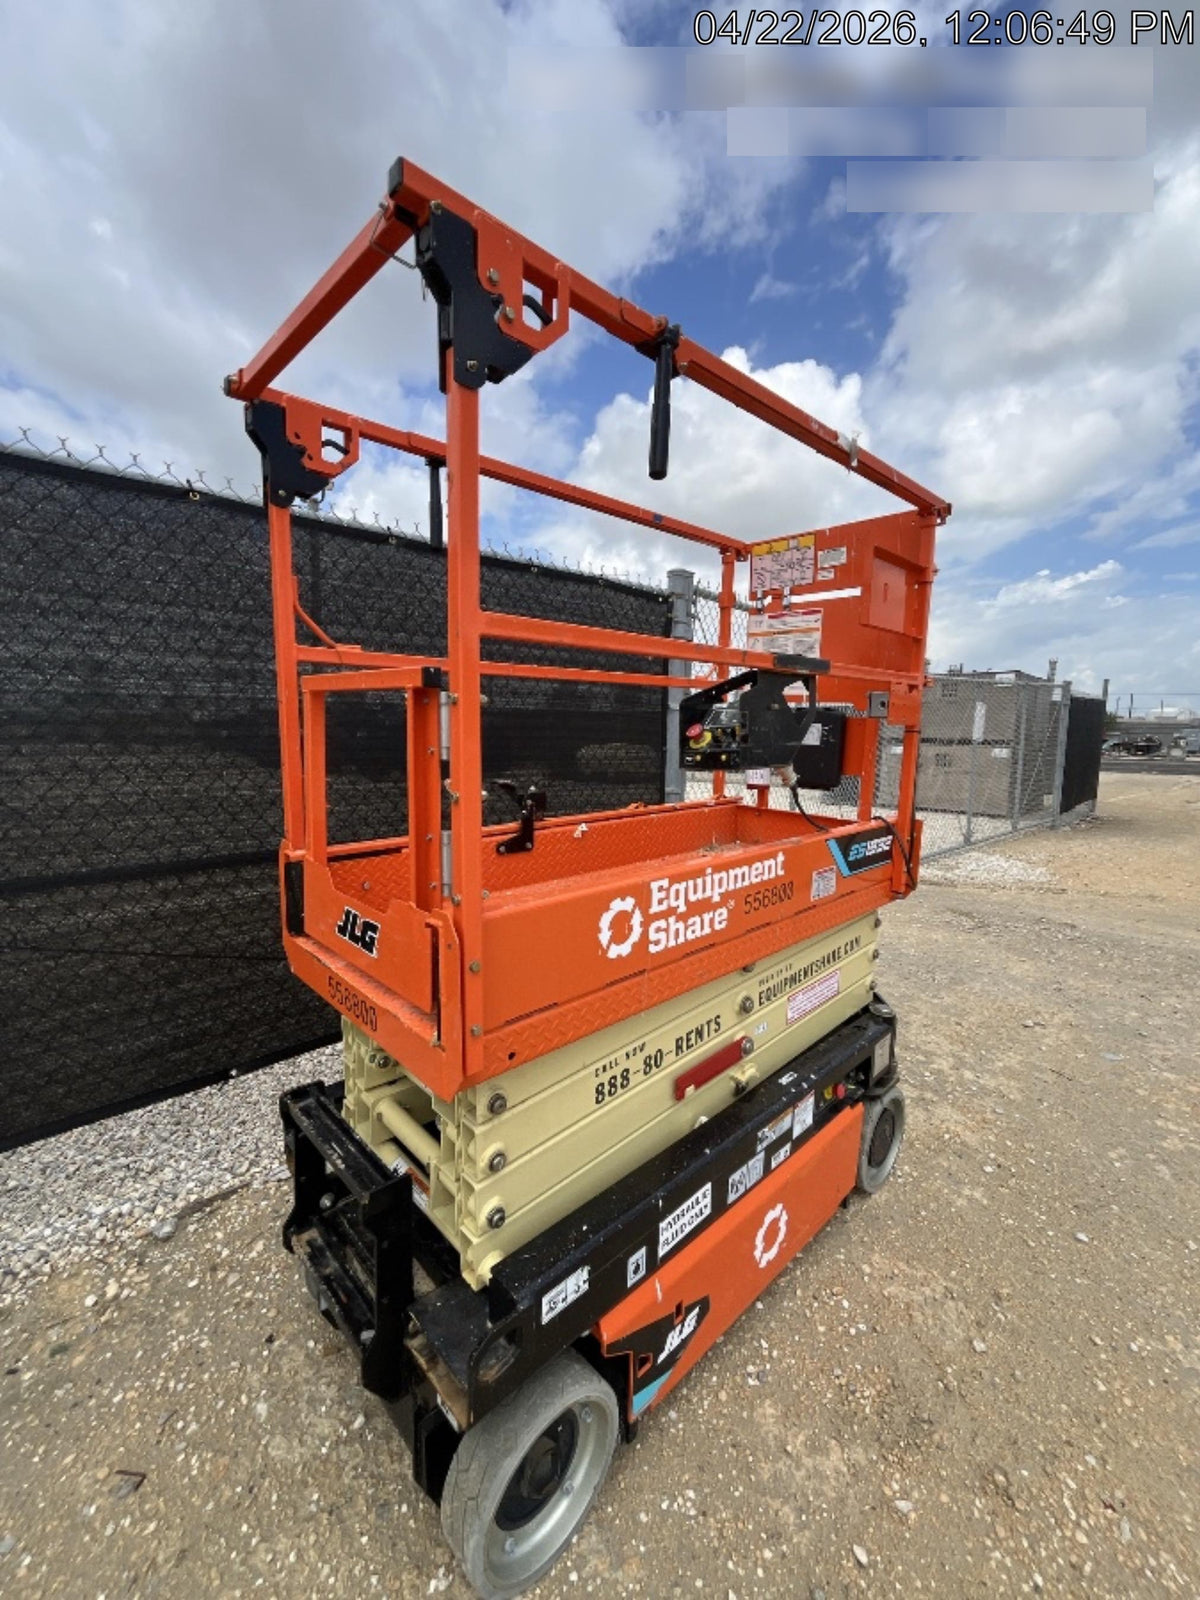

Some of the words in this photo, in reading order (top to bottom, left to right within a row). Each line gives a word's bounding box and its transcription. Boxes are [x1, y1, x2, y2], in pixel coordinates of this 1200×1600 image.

[649, 851, 785, 914] Equipment
[335, 905, 381, 959] JLG
[594, 1014, 722, 1105] 888-80-RENTS
[594, 1057, 620, 1079] CALL
[661, 1188, 710, 1237] HYDRAULIC
